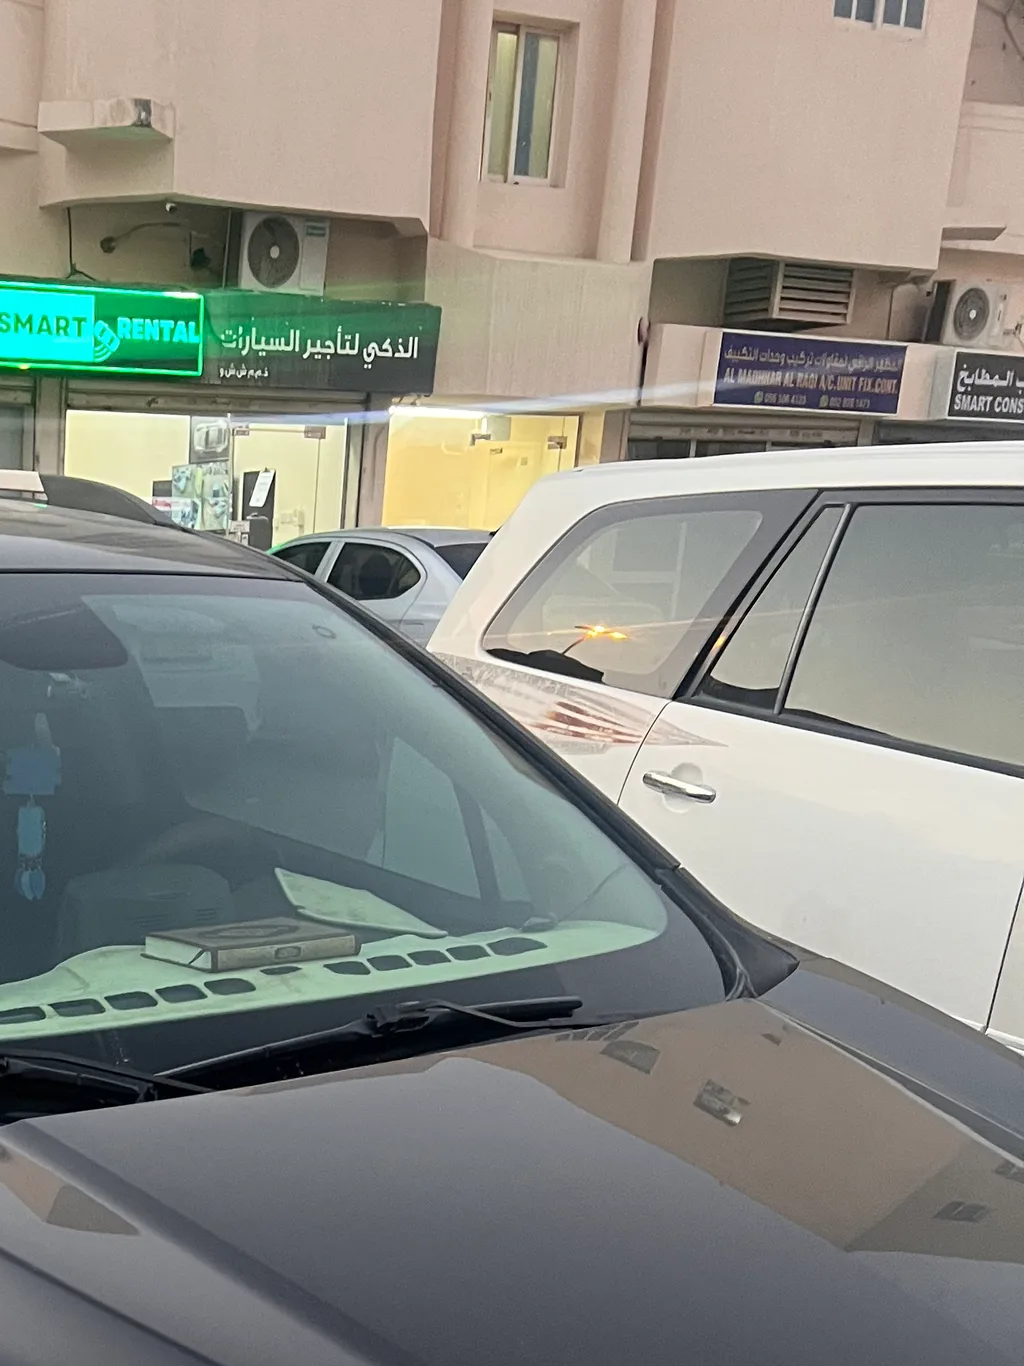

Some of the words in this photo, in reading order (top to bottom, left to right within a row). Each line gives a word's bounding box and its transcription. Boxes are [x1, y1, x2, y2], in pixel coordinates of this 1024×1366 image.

[117, 317, 200, 344] RENTAL
[221, 326, 300, 356] السيارات
[303, 326, 360, 360] لتأجير
[363, 335, 419, 369] الذكي
[724, 368, 735, 383] AL
[783, 370, 795, 388] AL
[957, 363, 1015, 392] المطابخ
[954, 394, 993, 412] SMART
[994, 396, 1024, 414] CONS
